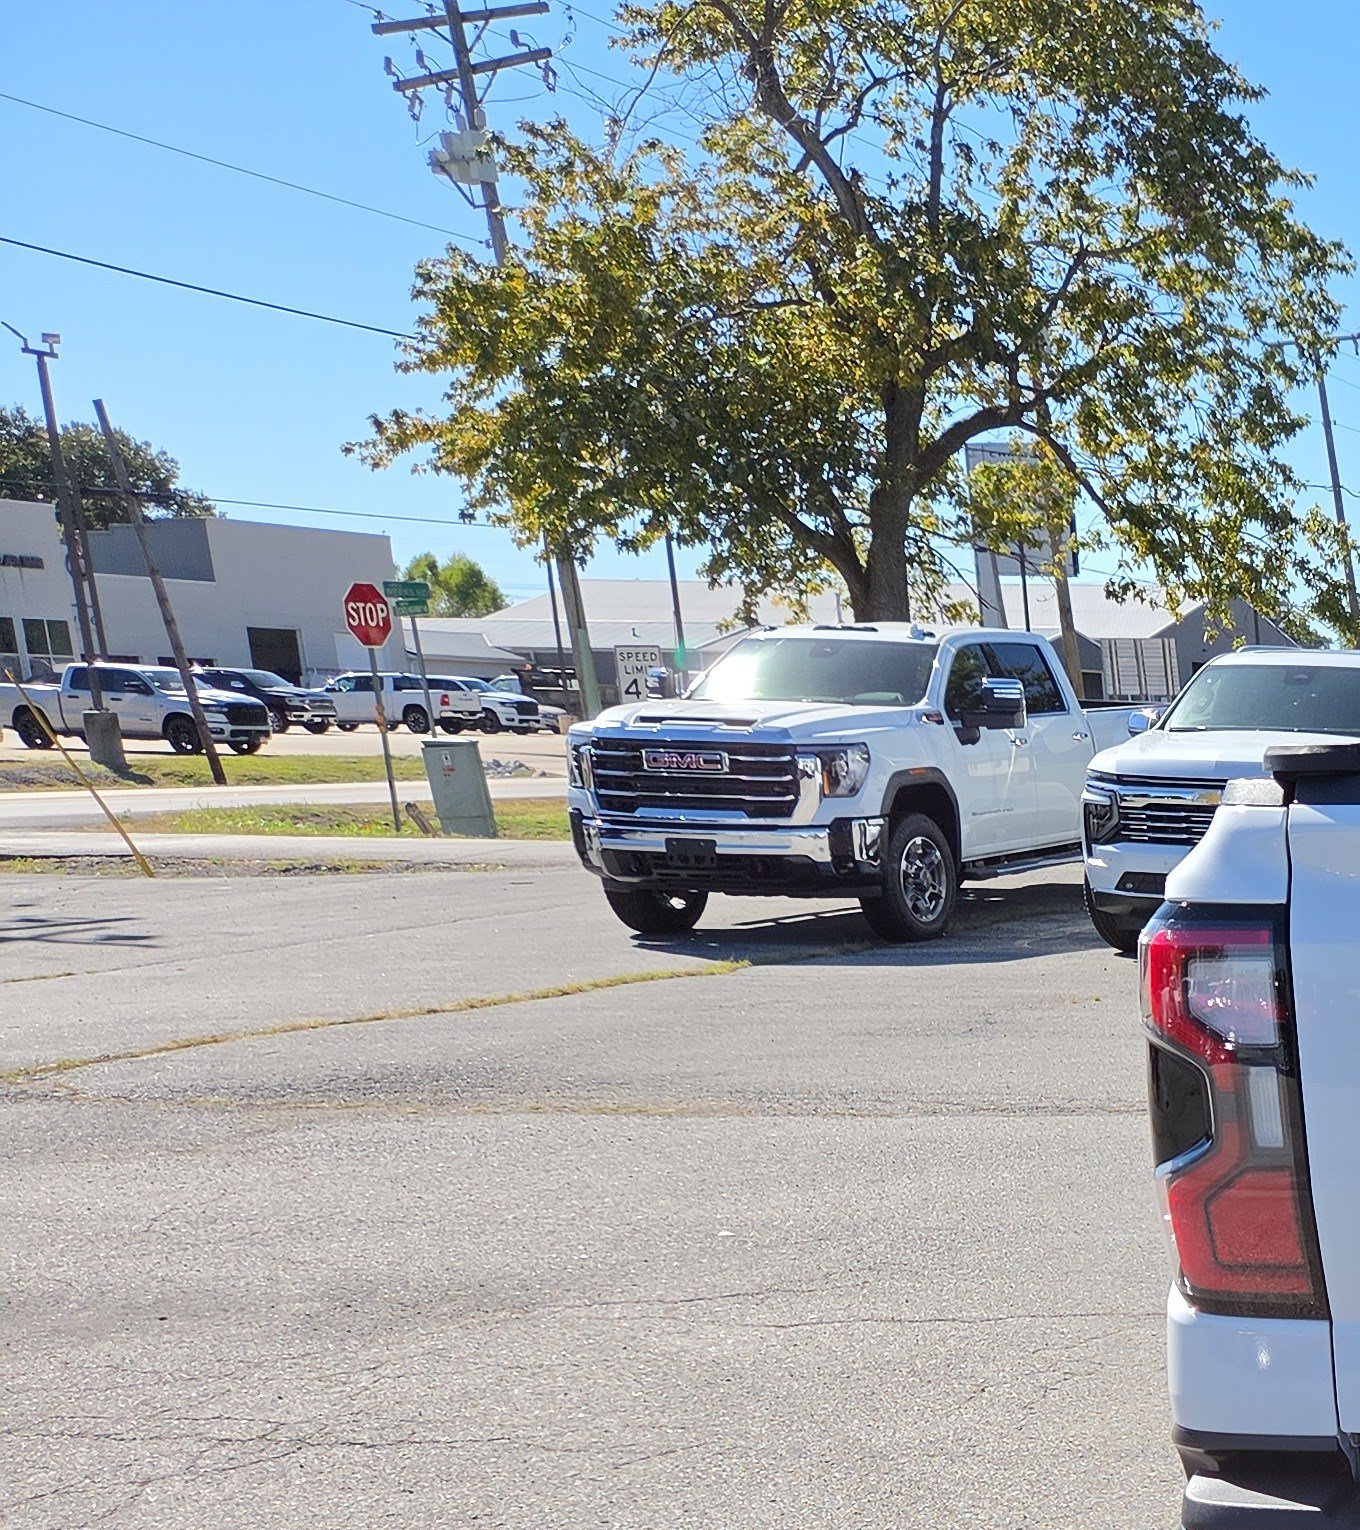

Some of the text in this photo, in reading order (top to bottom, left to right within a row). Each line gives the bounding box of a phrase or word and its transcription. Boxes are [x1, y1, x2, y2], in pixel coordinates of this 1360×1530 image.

[347, 602, 387, 627] STOP
[619, 651, 658, 661] SPEED
[646, 752, 722, 770] GMC
